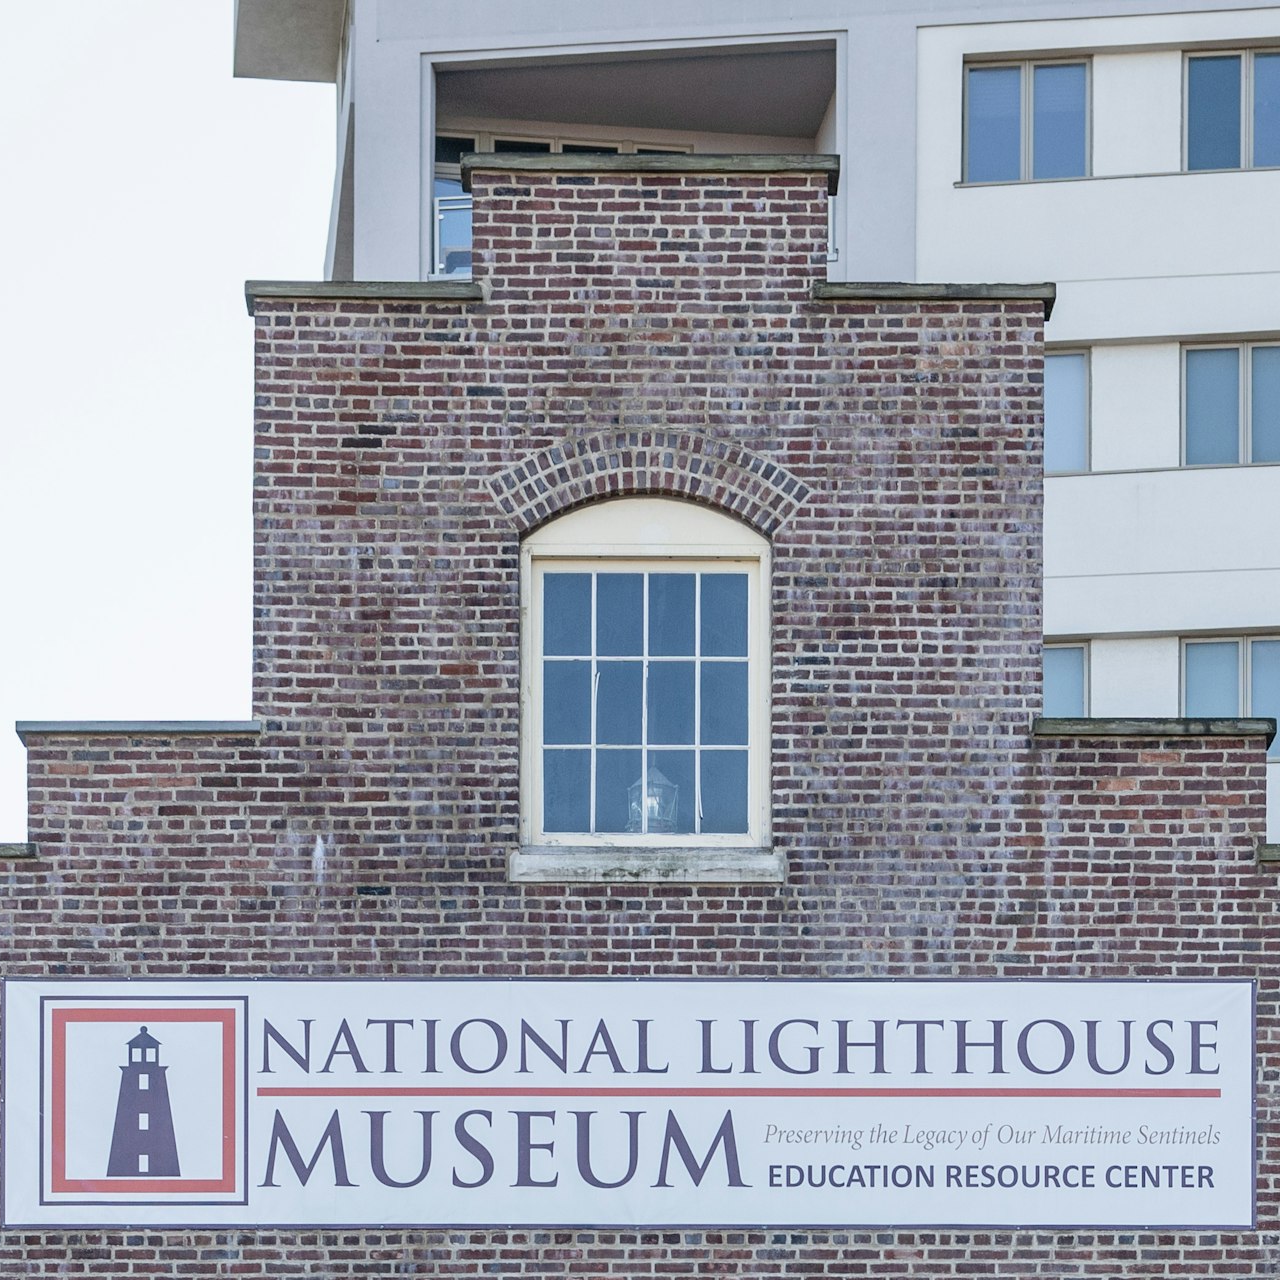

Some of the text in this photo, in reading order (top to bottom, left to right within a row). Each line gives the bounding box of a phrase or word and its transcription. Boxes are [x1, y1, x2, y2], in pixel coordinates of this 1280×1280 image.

[257, 1017, 1220, 1076] NATIONAL LIGHTHOUSE
[257, 1108, 753, 1189] MUSEUM
[763, 1123, 1221, 1150] Preserving the Legacy of Our Maritime Sentinels
[769, 1164, 1215, 1188] EDUCATION RESOURCE CENTER
